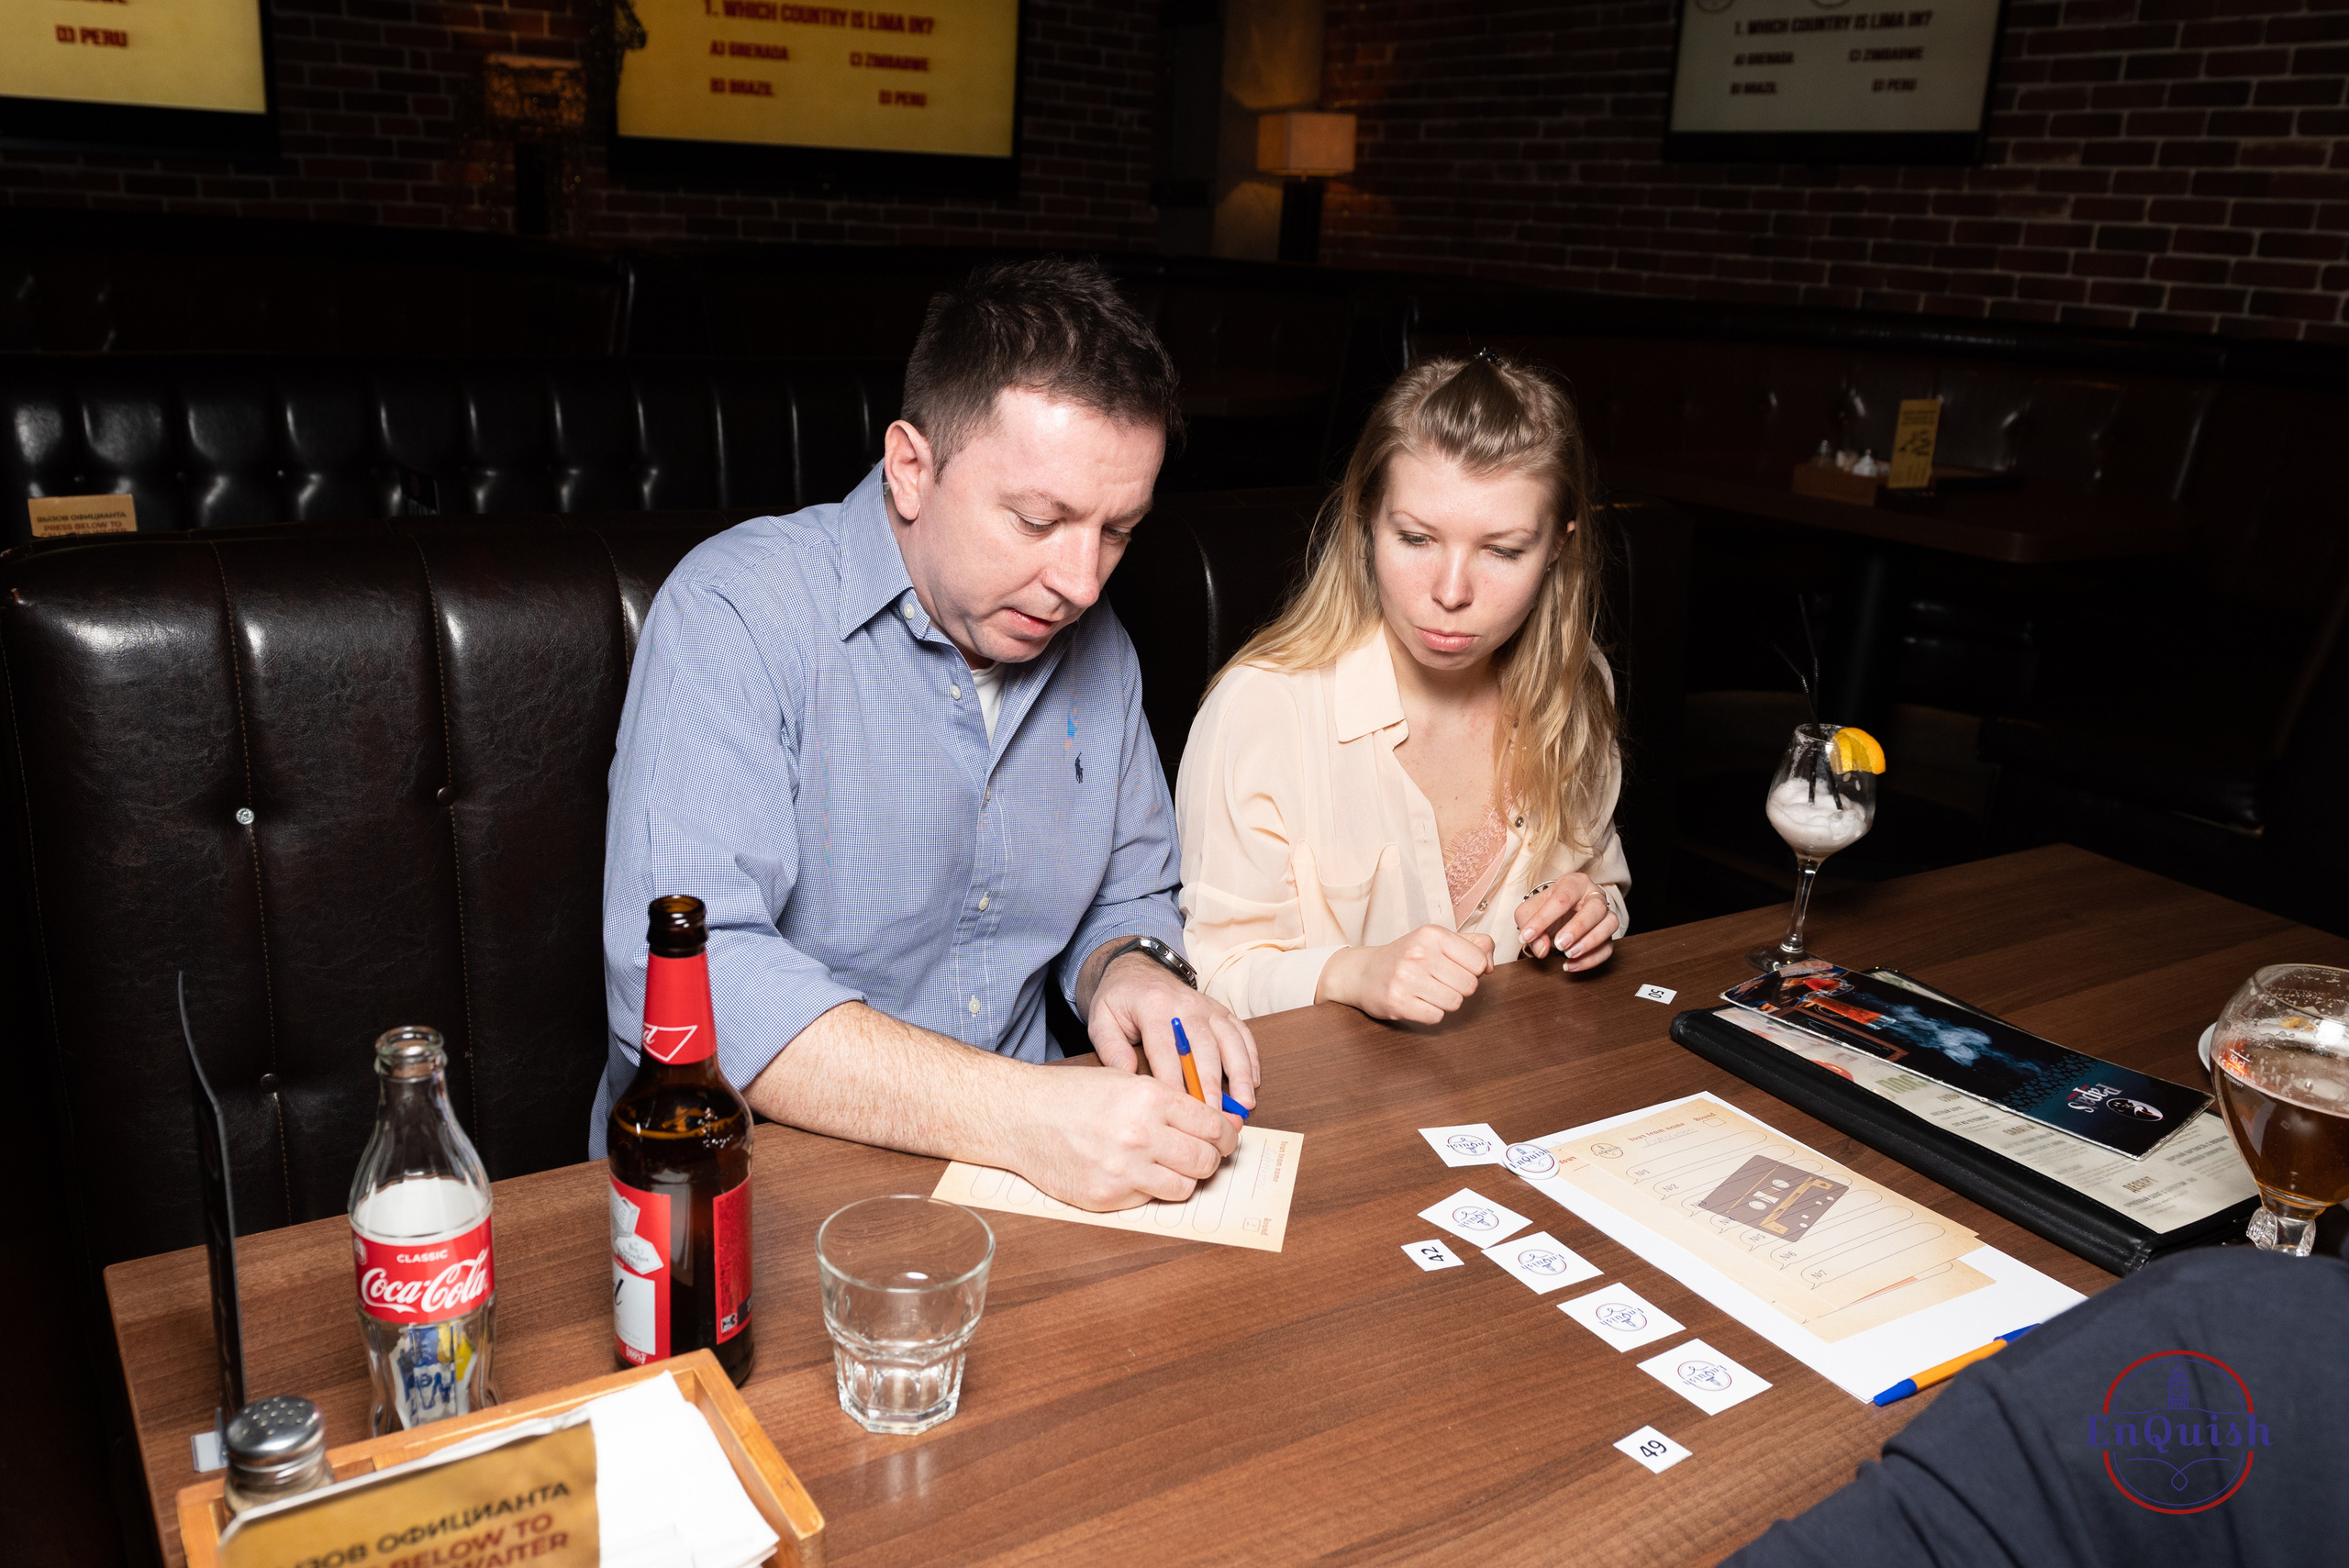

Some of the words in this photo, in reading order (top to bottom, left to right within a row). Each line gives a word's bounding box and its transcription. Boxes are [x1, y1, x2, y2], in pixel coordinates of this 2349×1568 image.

[80, 27, 128, 49] PERU
[1887, 78, 1918, 92] PERU
[896, 92, 927, 107] PERU
[37, 515, 69, 523] ВЫЗОВ
[70, 511, 127, 521] ОФИЦИАНТА
[44, 523, 72, 531] PRESS
[74, 521, 107, 529] BELOW
[1693, 1112, 1717, 1122] Round
[1627, 1133, 1646, 1142] Your
[1646, 1128, 1665, 1137] team
[1665, 1122, 1687, 1131] name
[2002, 1122, 2036, 1137] САЛАТЫ
[1278, 1140, 1289, 1152] Your
[1276, 1153, 1286, 1167] team
[1509, 1148, 1551, 1169] EnQuish
[1273, 1168, 1281, 1183] name
[2121, 1175, 2160, 1193] ДЕСЕРТ
[1457, 1207, 1495, 1229] EnQuish
[1260, 1218, 1272, 1237] Round
[396, 1249, 449, 1263] CLASSIC
[1419, 1246, 1445, 1263] 42
[1520, 1252, 1565, 1272] EnQuish
[362, 1246, 489, 1313] Coca-Cola
[1598, 1307, 1644, 1328] EnQuish
[1682, 1364, 1727, 1386] EnQuish
[1639, 1439, 1667, 1458] 49
[376, 1482, 570, 1554] ОФИЦИАНТА
[516, 1514, 553, 1539] TO
